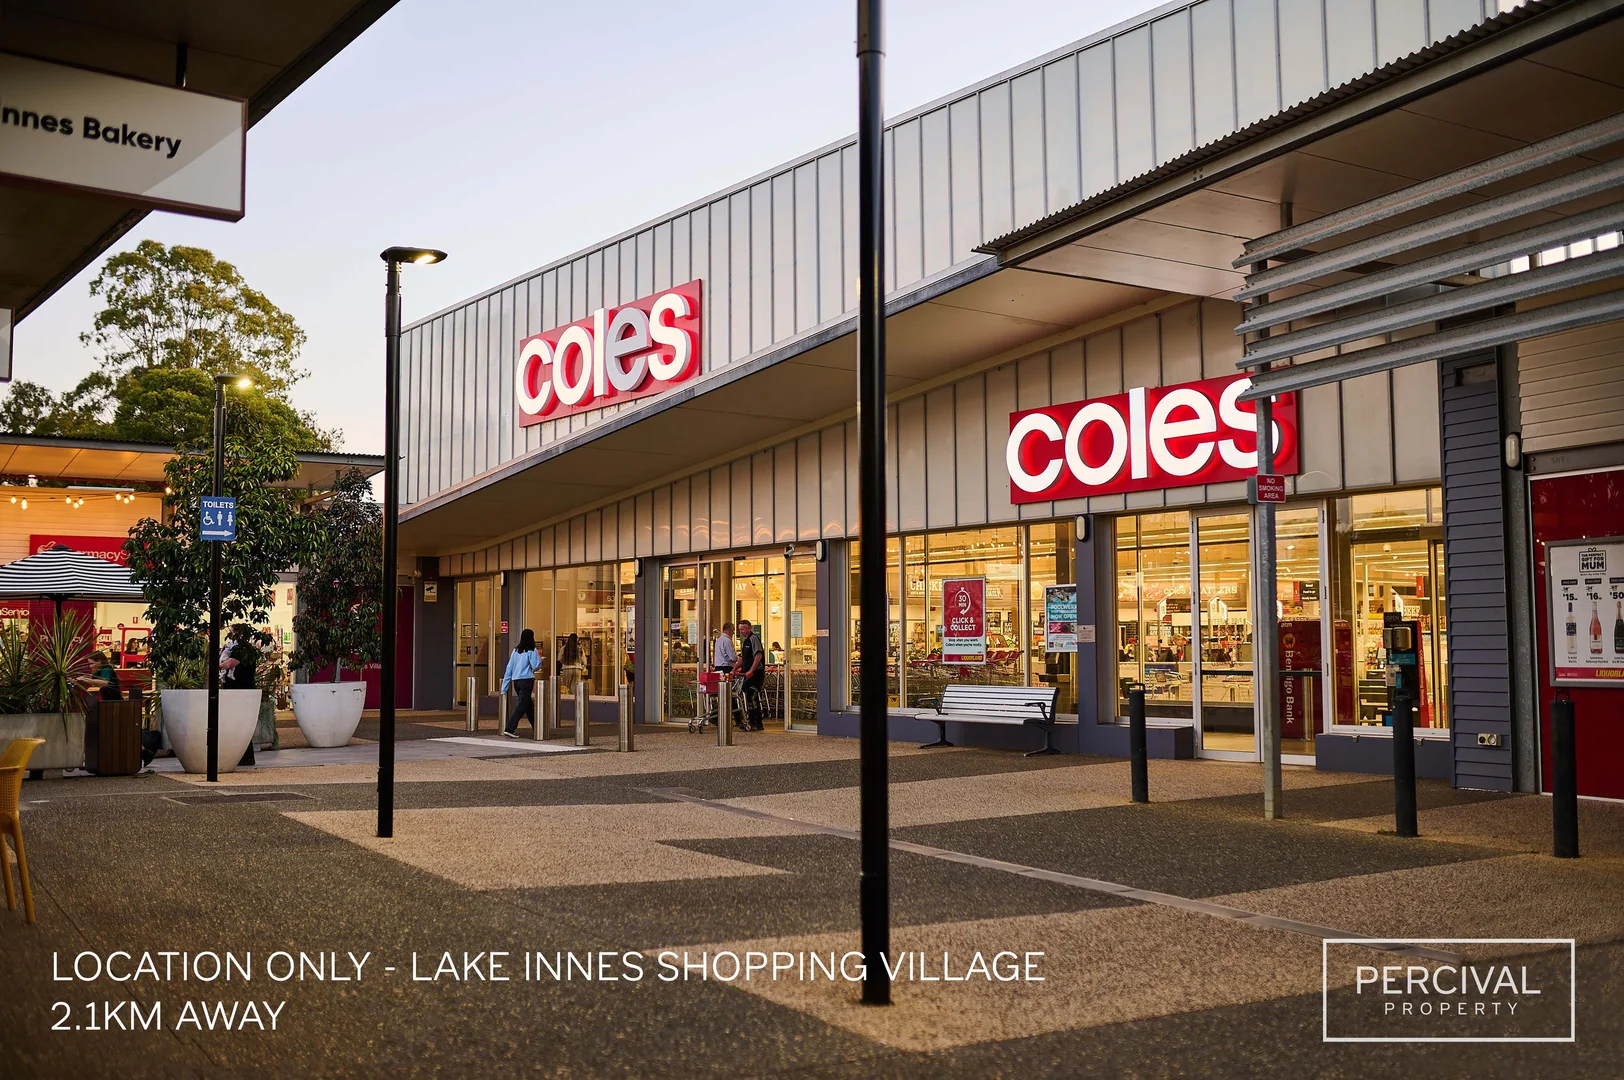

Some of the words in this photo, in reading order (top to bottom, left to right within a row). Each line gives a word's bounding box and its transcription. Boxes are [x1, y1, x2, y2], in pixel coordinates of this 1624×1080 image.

[83, 116, 182, 159] Bakery
[516, 293, 691, 415] coles
[1006, 377, 1280, 493] coles
[202, 500, 235, 509] TOILETS
[1581, 561, 1605, 570] MUM
[949, 624, 976, 632] COLLECT
[1284, 650, 1295, 693] Benigo
[1286, 697, 1295, 724] Bank
